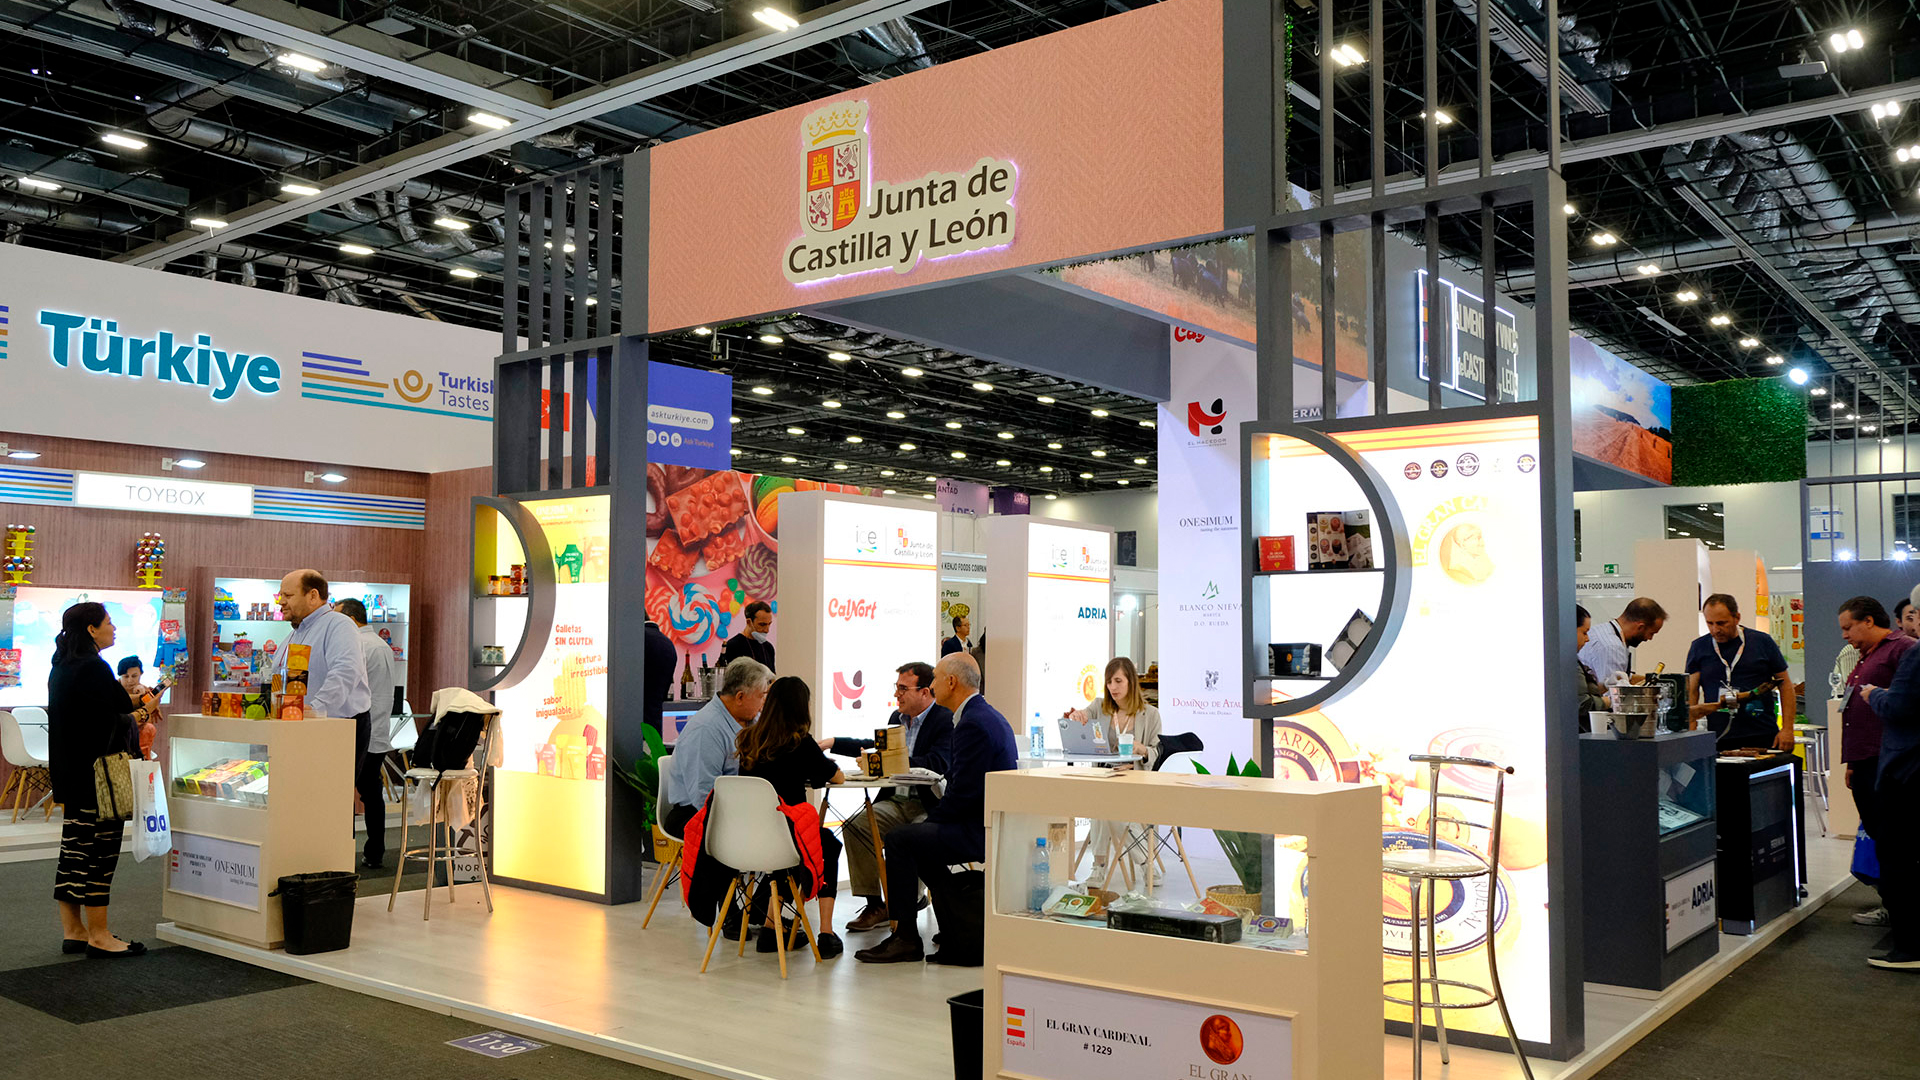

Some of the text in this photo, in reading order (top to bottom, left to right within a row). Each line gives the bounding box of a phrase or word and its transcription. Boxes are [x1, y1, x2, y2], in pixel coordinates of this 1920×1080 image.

[869, 165, 1008, 219] Junta de
[789, 208, 1008, 274] Castilla y León
[41, 311, 281, 400] Türkiye
[439, 389, 489, 411] Tastes
[651, 410, 709, 425] askturkiye.com
[1293, 407, 1321, 419] ERM
[125, 485, 205, 506] TOYBOX
[1179, 515, 1233, 528] ONESIMUM
[946, 589, 960, 597] Peas
[828, 598, 877, 621] CalNort
[1078, 606, 1107, 620] ADRIA
[555, 637, 567, 646] SIN
[575, 655, 602, 665] textura
[543, 695, 563, 705] sabor
[536, 706, 572, 719] inigualable
[214, 859, 255, 878] ONESIMUM
[1691, 879, 1714, 909] ADRIA
[1046, 1018, 1151, 1047] EL GRAN CARDENAL
[1006, 1037, 1026, 1048] España
[1083, 1042, 1113, 1056] # 1229
[1189, 1063, 1206, 1079] EL
